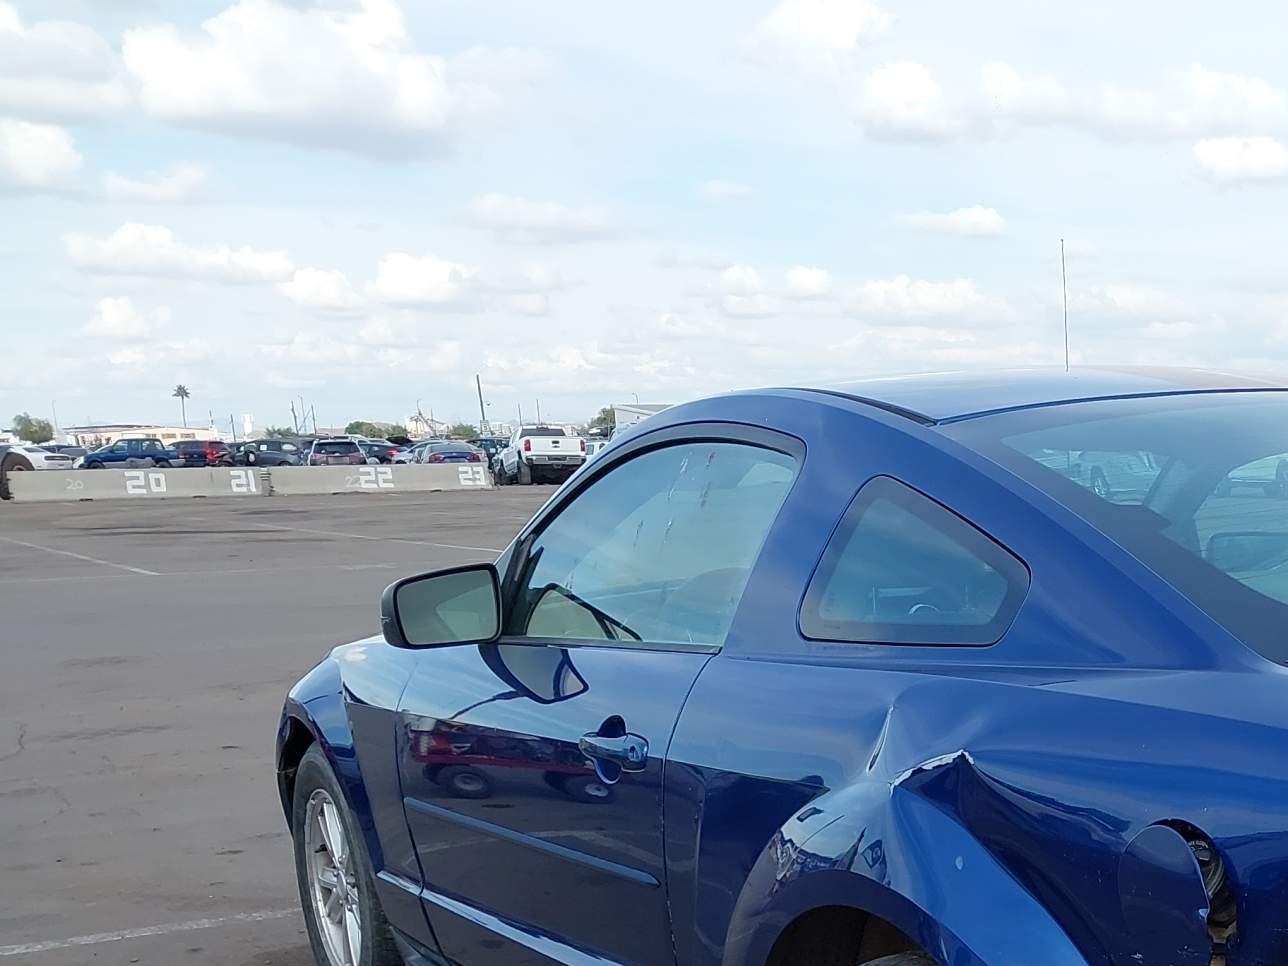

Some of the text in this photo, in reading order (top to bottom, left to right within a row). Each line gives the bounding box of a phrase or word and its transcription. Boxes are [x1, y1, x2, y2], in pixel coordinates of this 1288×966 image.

[64, 478, 85, 490] 20
[124, 471, 167, 494] 20
[229, 470, 256, 493] 21
[359, 467, 394, 488] 22
[458, 466, 485, 486] 23
